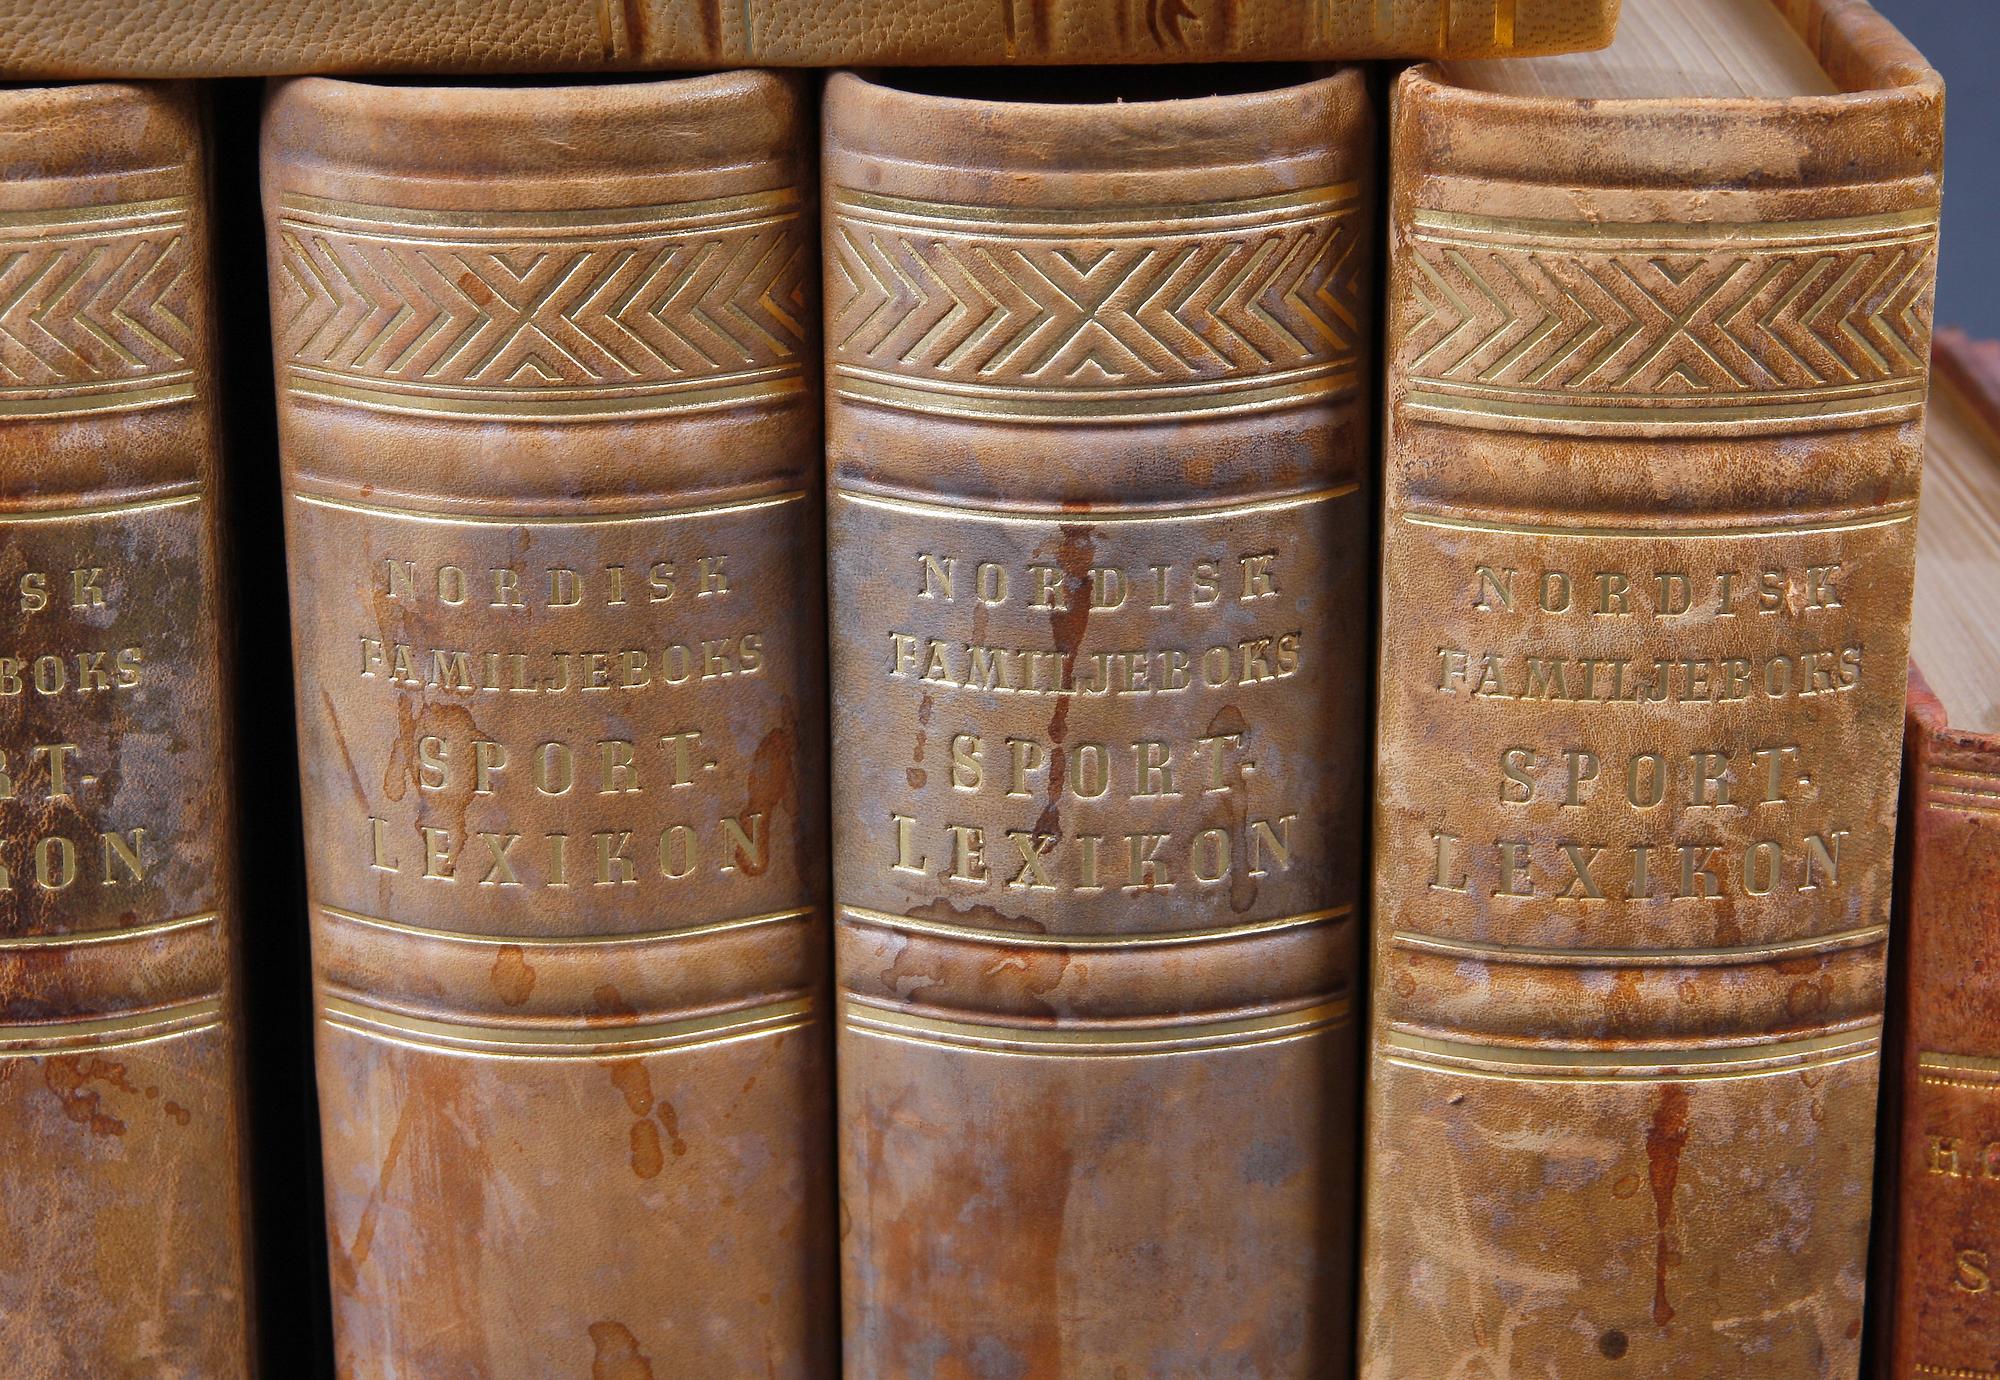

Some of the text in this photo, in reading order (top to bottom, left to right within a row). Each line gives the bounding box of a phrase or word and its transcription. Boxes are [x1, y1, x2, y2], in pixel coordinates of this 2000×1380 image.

[384, 554, 730, 607] NORDISK
[917, 552, 1280, 613] NORDISK
[1474, 564, 1843, 617] NORDISK
[360, 632, 765, 693] FAMILJEBOKS
[888, 630, 1302, 697] FAMILJEBOKS
[1436, 643, 1864, 704] FAMILJEBOKS
[417, 731, 717, 797] SPORT-
[951, 733, 1257, 799] SPORT-
[1500, 745, 1811, 811] SPORT-
[367, 812, 764, 887] LEXIKON
[891, 813, 1298, 891] LEXIKON
[1430, 830, 1850, 901] LEXIKON
